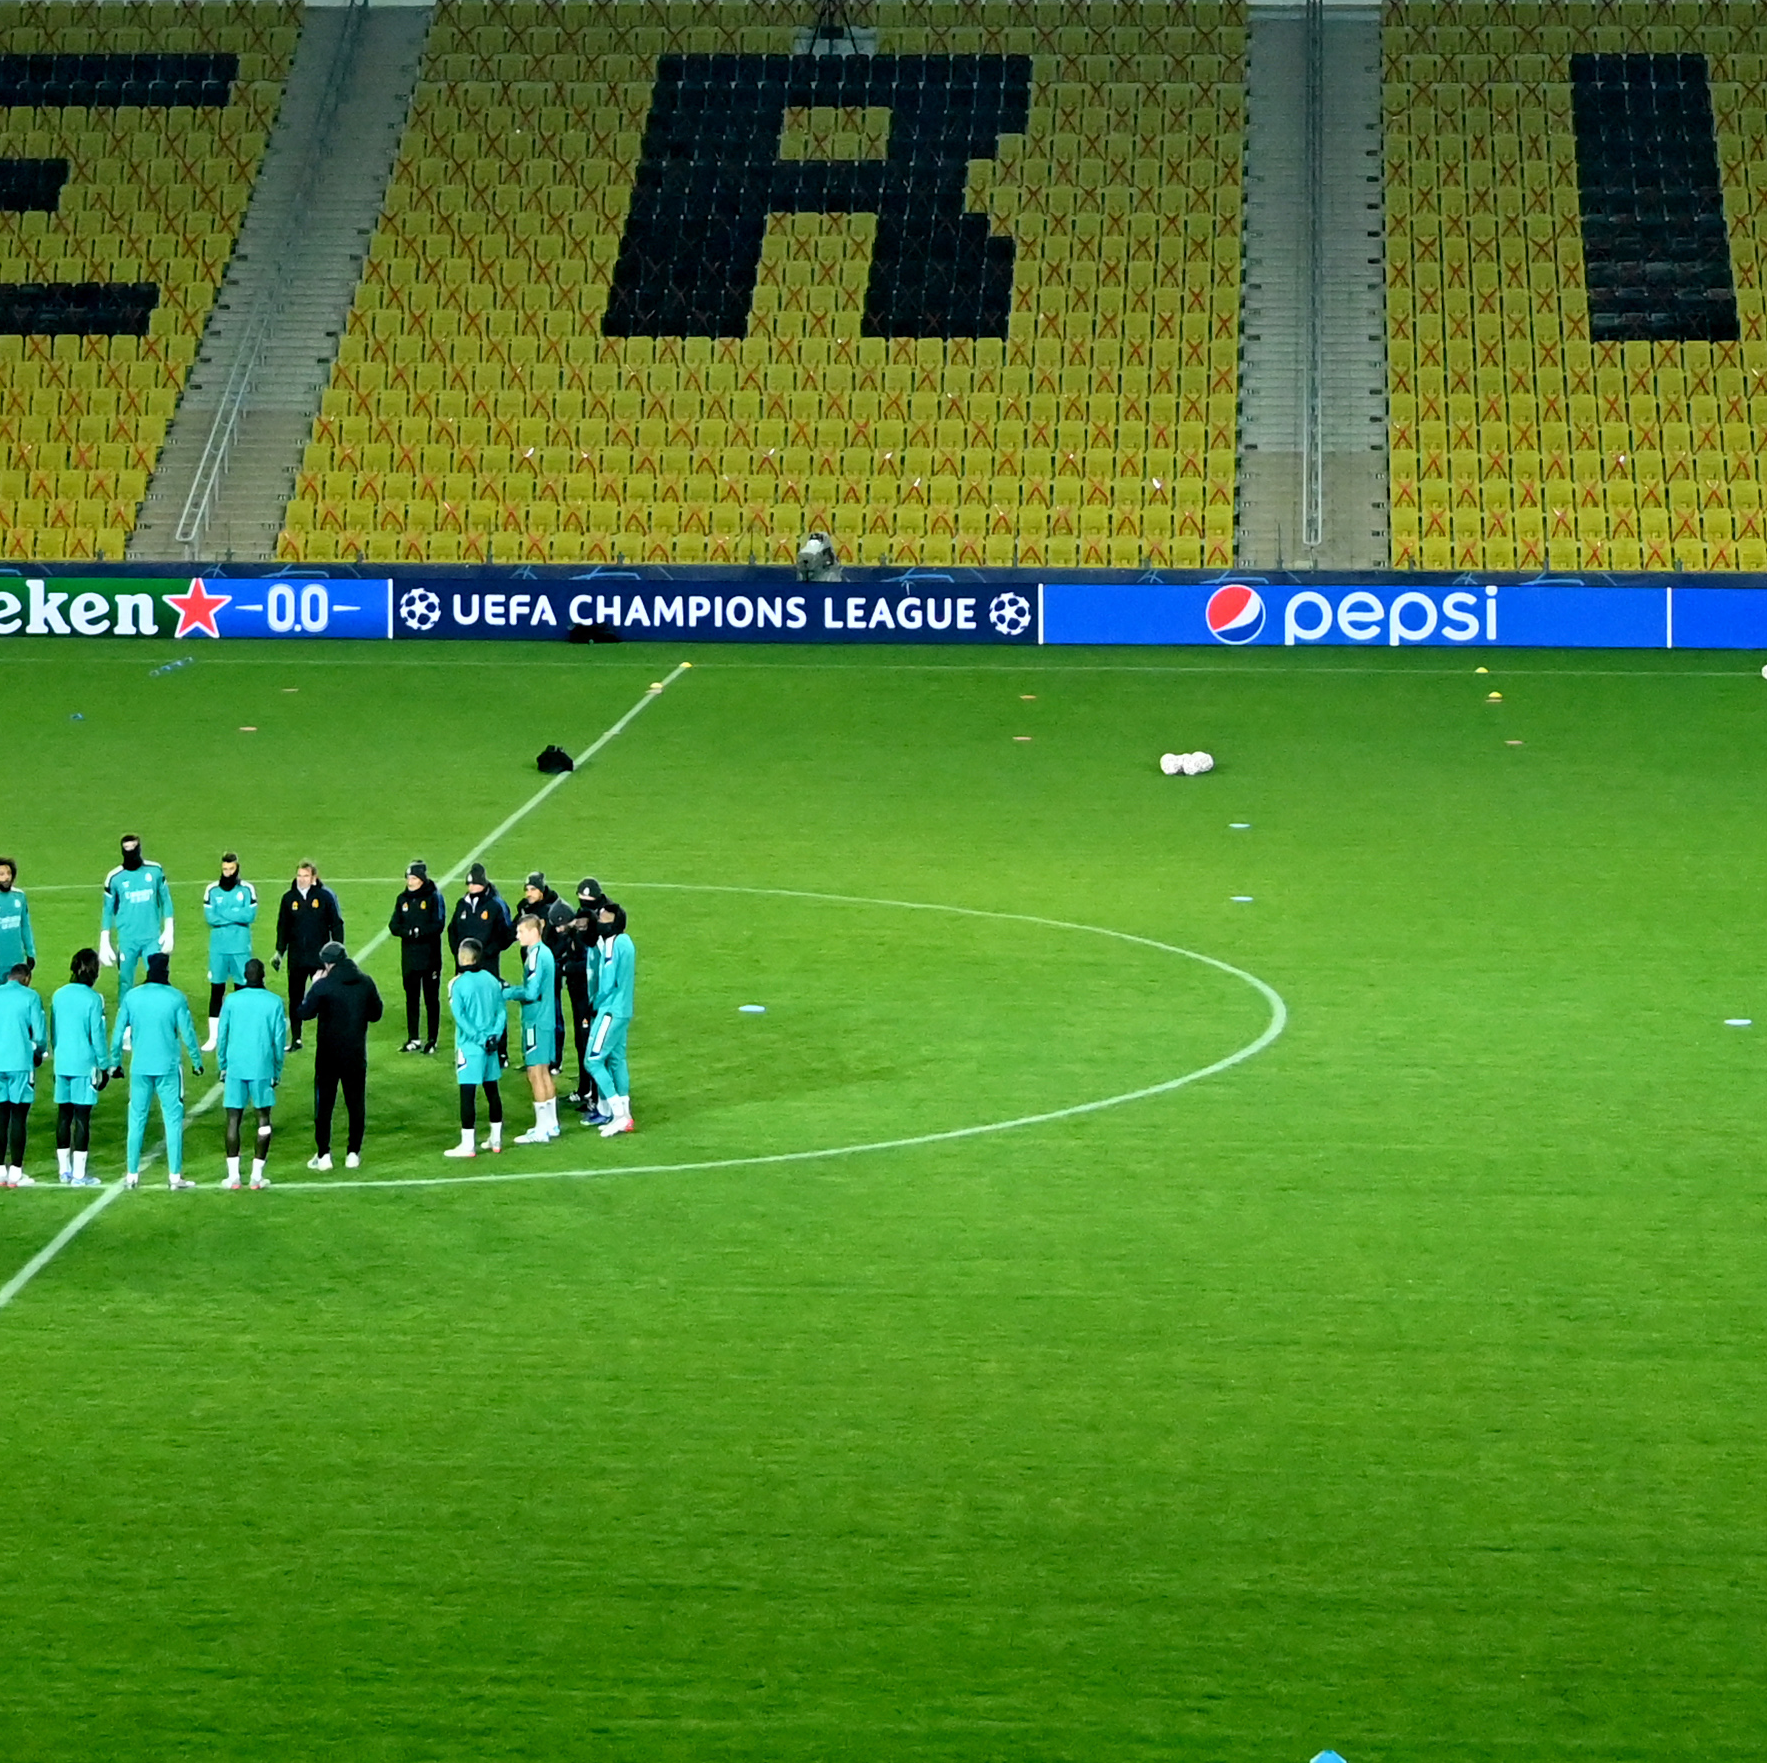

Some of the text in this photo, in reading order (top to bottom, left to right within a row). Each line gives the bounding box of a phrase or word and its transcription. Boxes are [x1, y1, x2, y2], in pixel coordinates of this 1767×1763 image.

[266, 583, 330, 633] 0.0
[453, 594, 978, 630] UEFA CHAMPIONS LEAGUE
[1284, 585, 1498, 646] pepsi
